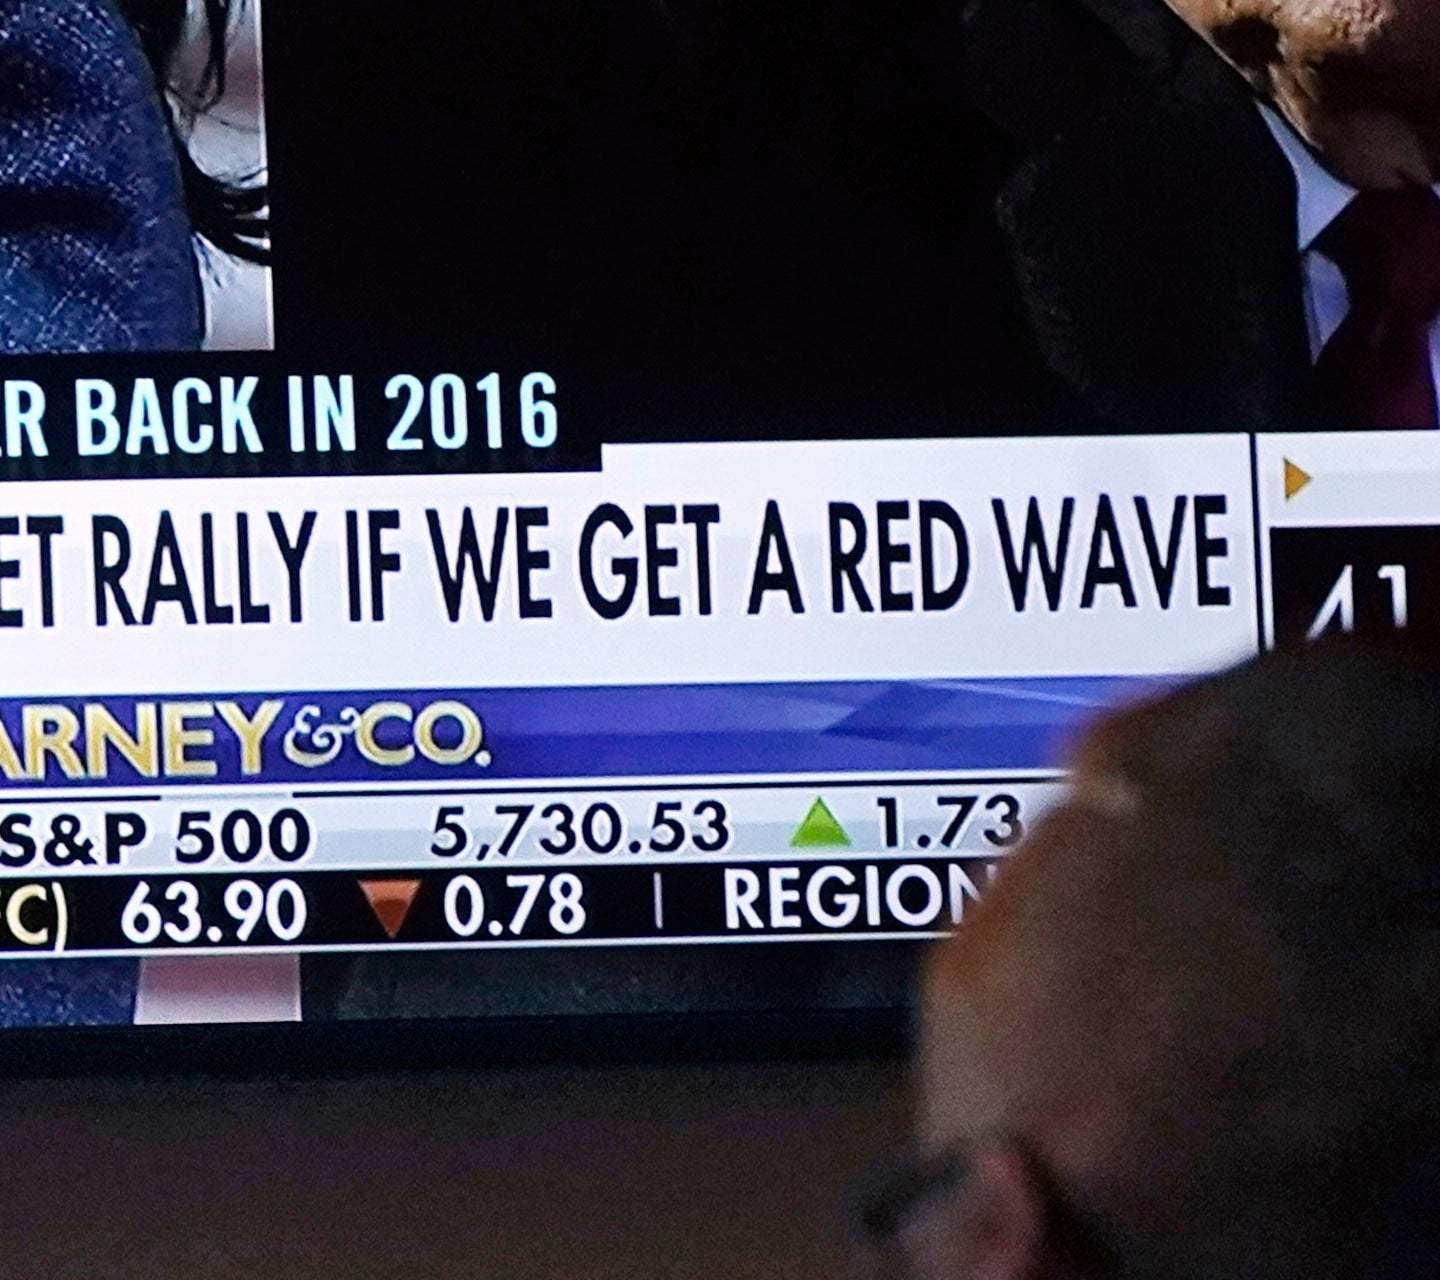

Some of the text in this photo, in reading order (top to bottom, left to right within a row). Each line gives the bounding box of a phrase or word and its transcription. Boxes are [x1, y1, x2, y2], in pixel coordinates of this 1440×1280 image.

[74, 375, 265, 457] BACK
[286, 373, 357, 454] IN
[383, 370, 559, 452] 2016
[90, 508, 319, 628] RALLY
[344, 508, 402, 623] IF
[423, 505, 554, 624] WE
[577, 501, 722, 621] GET
[746, 498, 807, 616] A
[827, 498, 971, 615] RED
[990, 492, 1232, 614] WAVE
[174, 806, 312, 865] 500
[429, 800, 732, 859] 5,730.53
[875, 793, 1022, 849] 1.73
[120, 877, 308, 945] 63.90
[443, 871, 587, 938] 0.78
